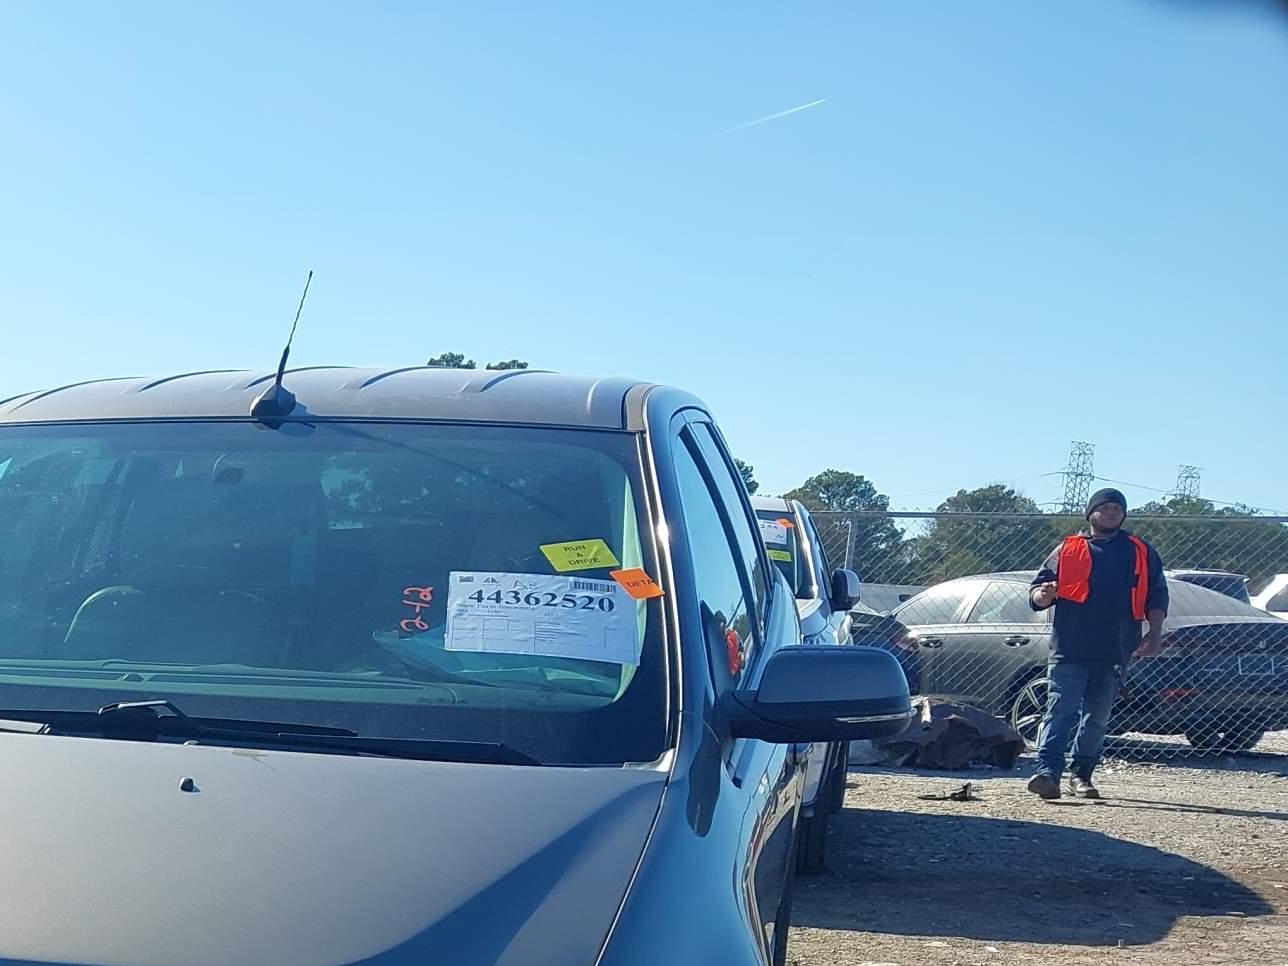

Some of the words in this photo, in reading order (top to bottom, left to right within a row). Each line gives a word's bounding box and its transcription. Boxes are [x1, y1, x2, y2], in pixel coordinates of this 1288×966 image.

[563, 544, 586, 552] RUN
[568, 557, 601, 566] DRIVE
[468, 588, 615, 613] 44362520
